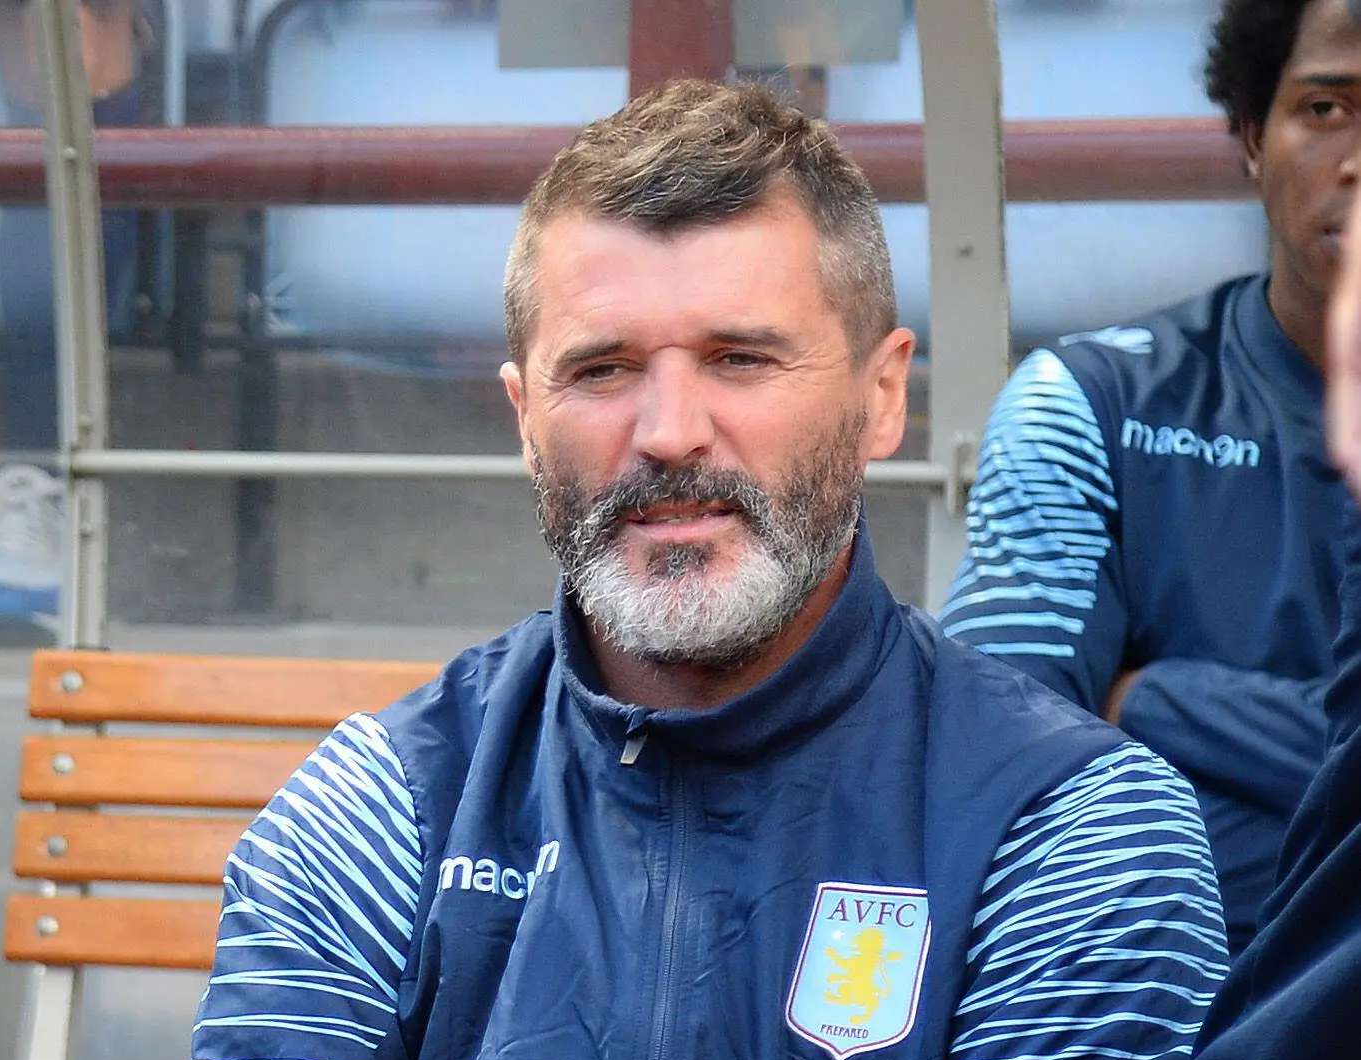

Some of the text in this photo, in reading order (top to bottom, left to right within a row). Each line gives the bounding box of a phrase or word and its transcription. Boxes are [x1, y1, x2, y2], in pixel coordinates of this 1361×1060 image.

[437, 840, 560, 900] macn
[827, 897, 918, 928] AVFC
[819, 1023, 870, 1040] PREPARED
